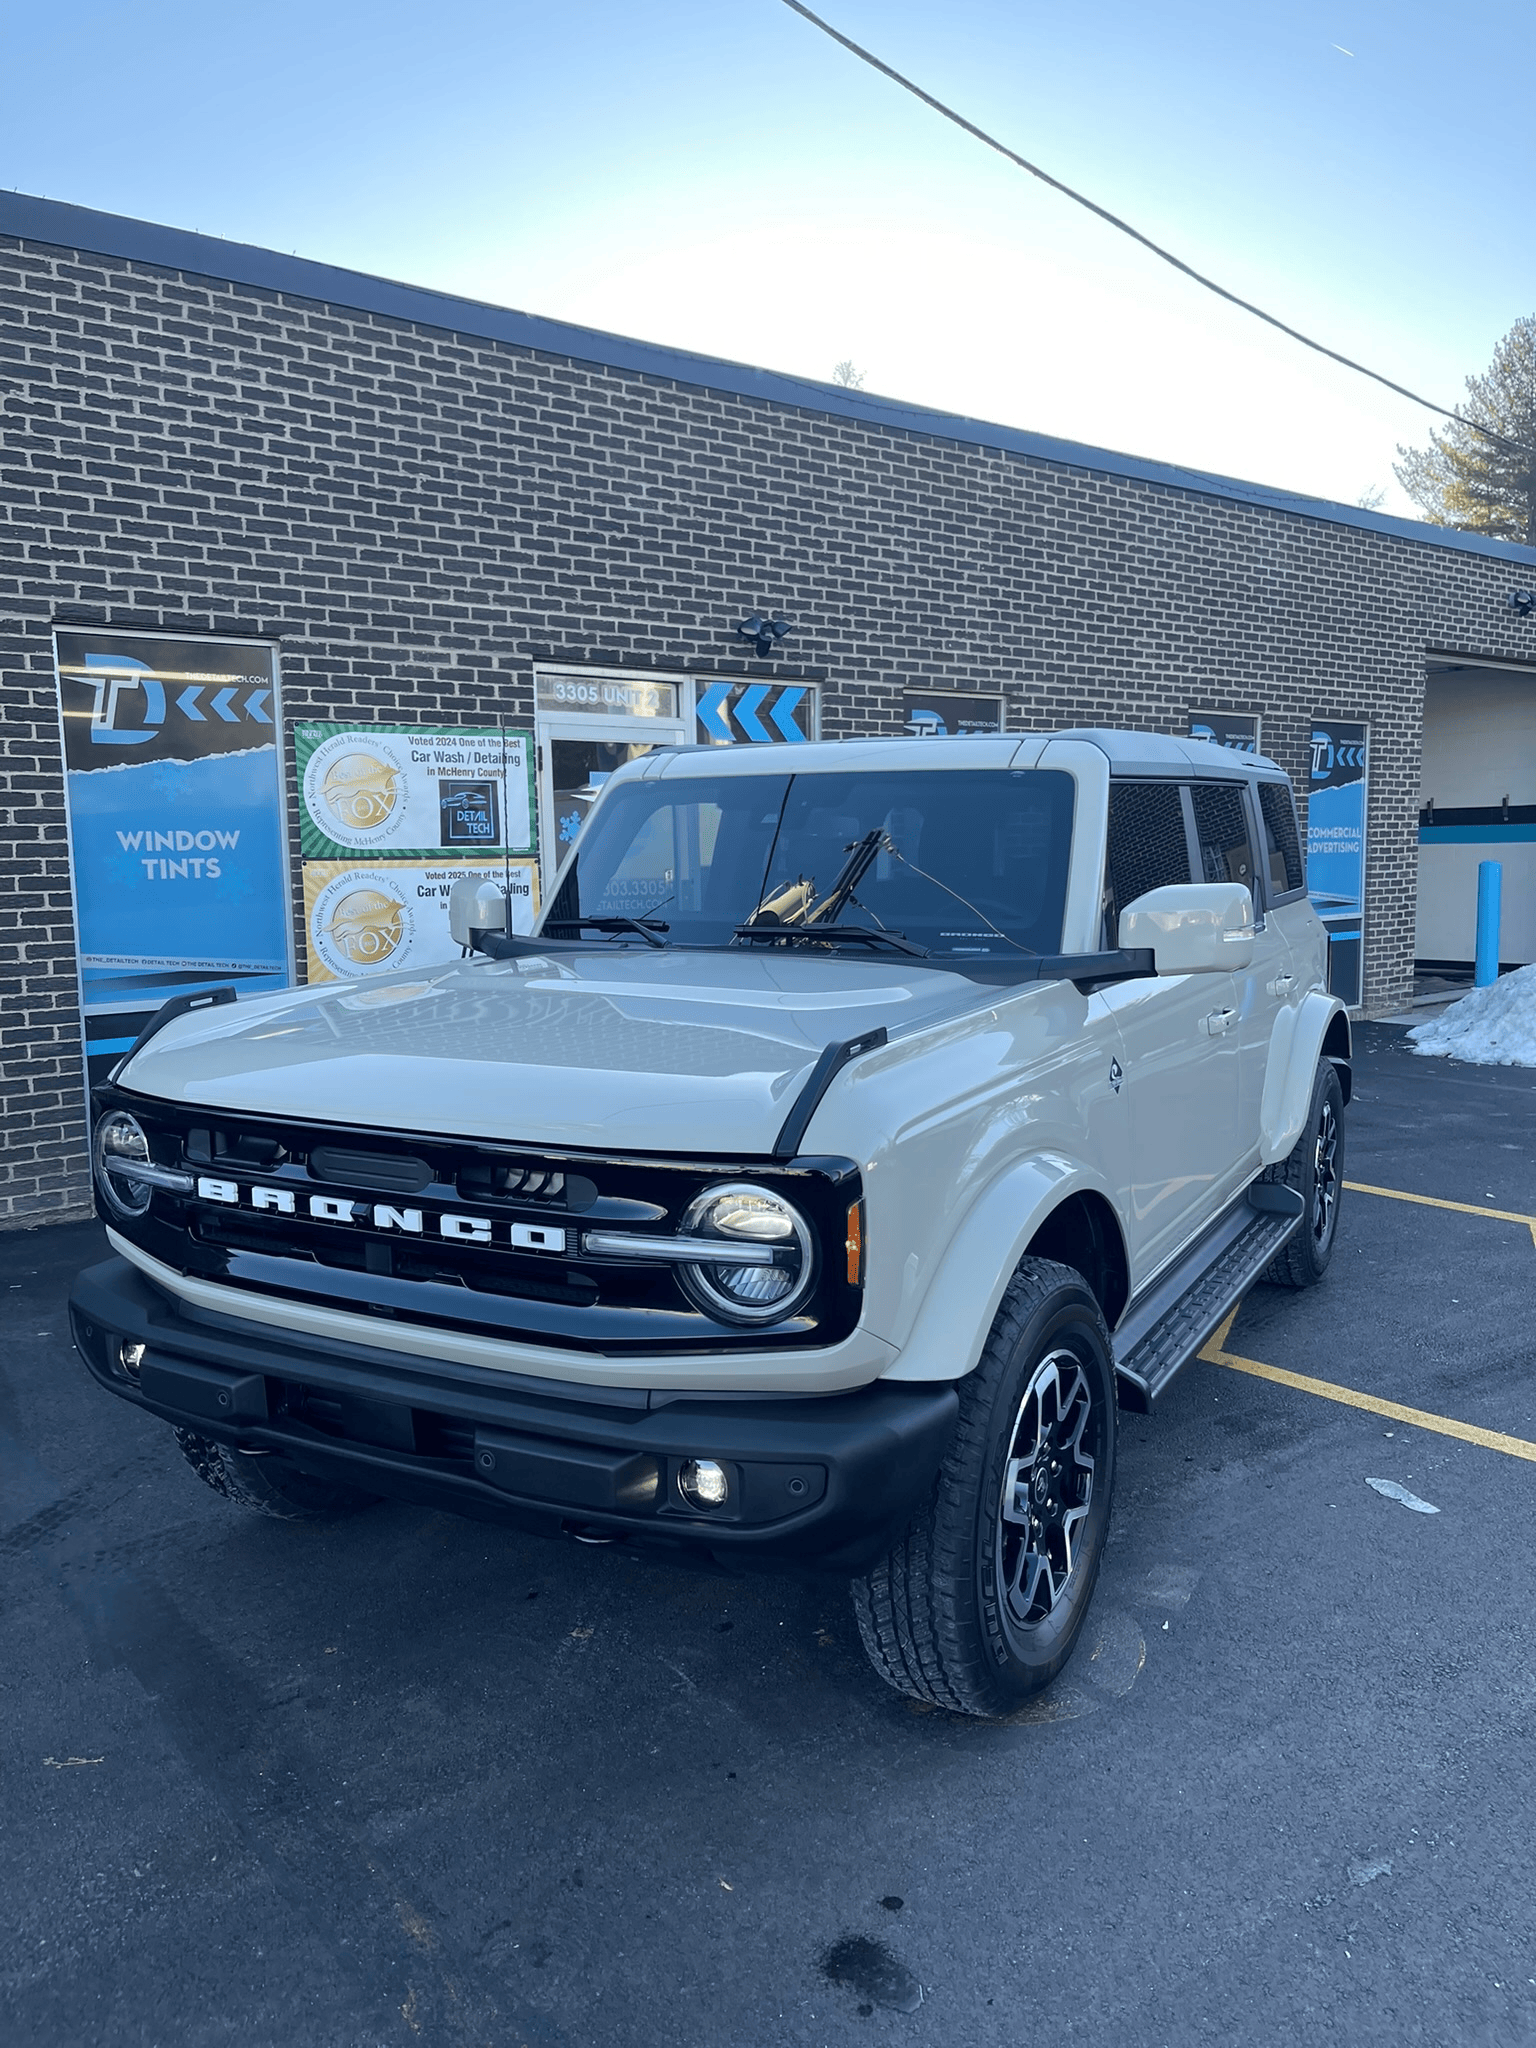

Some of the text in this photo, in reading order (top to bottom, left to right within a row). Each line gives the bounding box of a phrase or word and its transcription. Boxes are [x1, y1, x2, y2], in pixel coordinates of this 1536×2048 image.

[556, 683, 660, 707] 3305 UNIT 2
[408, 736, 521, 748] Voted 2024 One of the Best
[411, 750, 431, 763] Car
[433, 751, 464, 763] Wash
[308, 756, 323, 799] Northwest
[320, 737, 346, 757] Herald
[382, 745, 403, 770] Choice
[401, 773, 411, 802] Awards
[427, 766, 436, 776] in
[437, 767, 476, 778] McHenry
[456, 810, 488, 822] DETAIL
[313, 809, 407, 846] Representing McHenry County
[466, 823, 490, 834] TECH
[1307, 827, 1361, 839] COMMERCIAL
[116, 829, 240, 852] WINDOW
[1307, 841, 1359, 853] ADVERTISING
[141, 857, 222, 880] TINTS
[425, 871, 446, 880] Voted
[448, 871, 467, 880] 2025
[468, 870, 482, 879] One
[483, 870, 491, 878] of
[492, 870, 504, 878] the
[417, 885, 437, 897] Car
[315, 895, 330, 937] Northwest
[327, 874, 353, 894] Herald
[389, 880, 409, 905] Choice
[407, 907, 416, 936] Awards
[440, 901, 448, 910] in
[342, 926, 398, 960] FOX
[320, 946, 413, 977] Representin County
[198, 1176, 565, 1252] BRONCO
